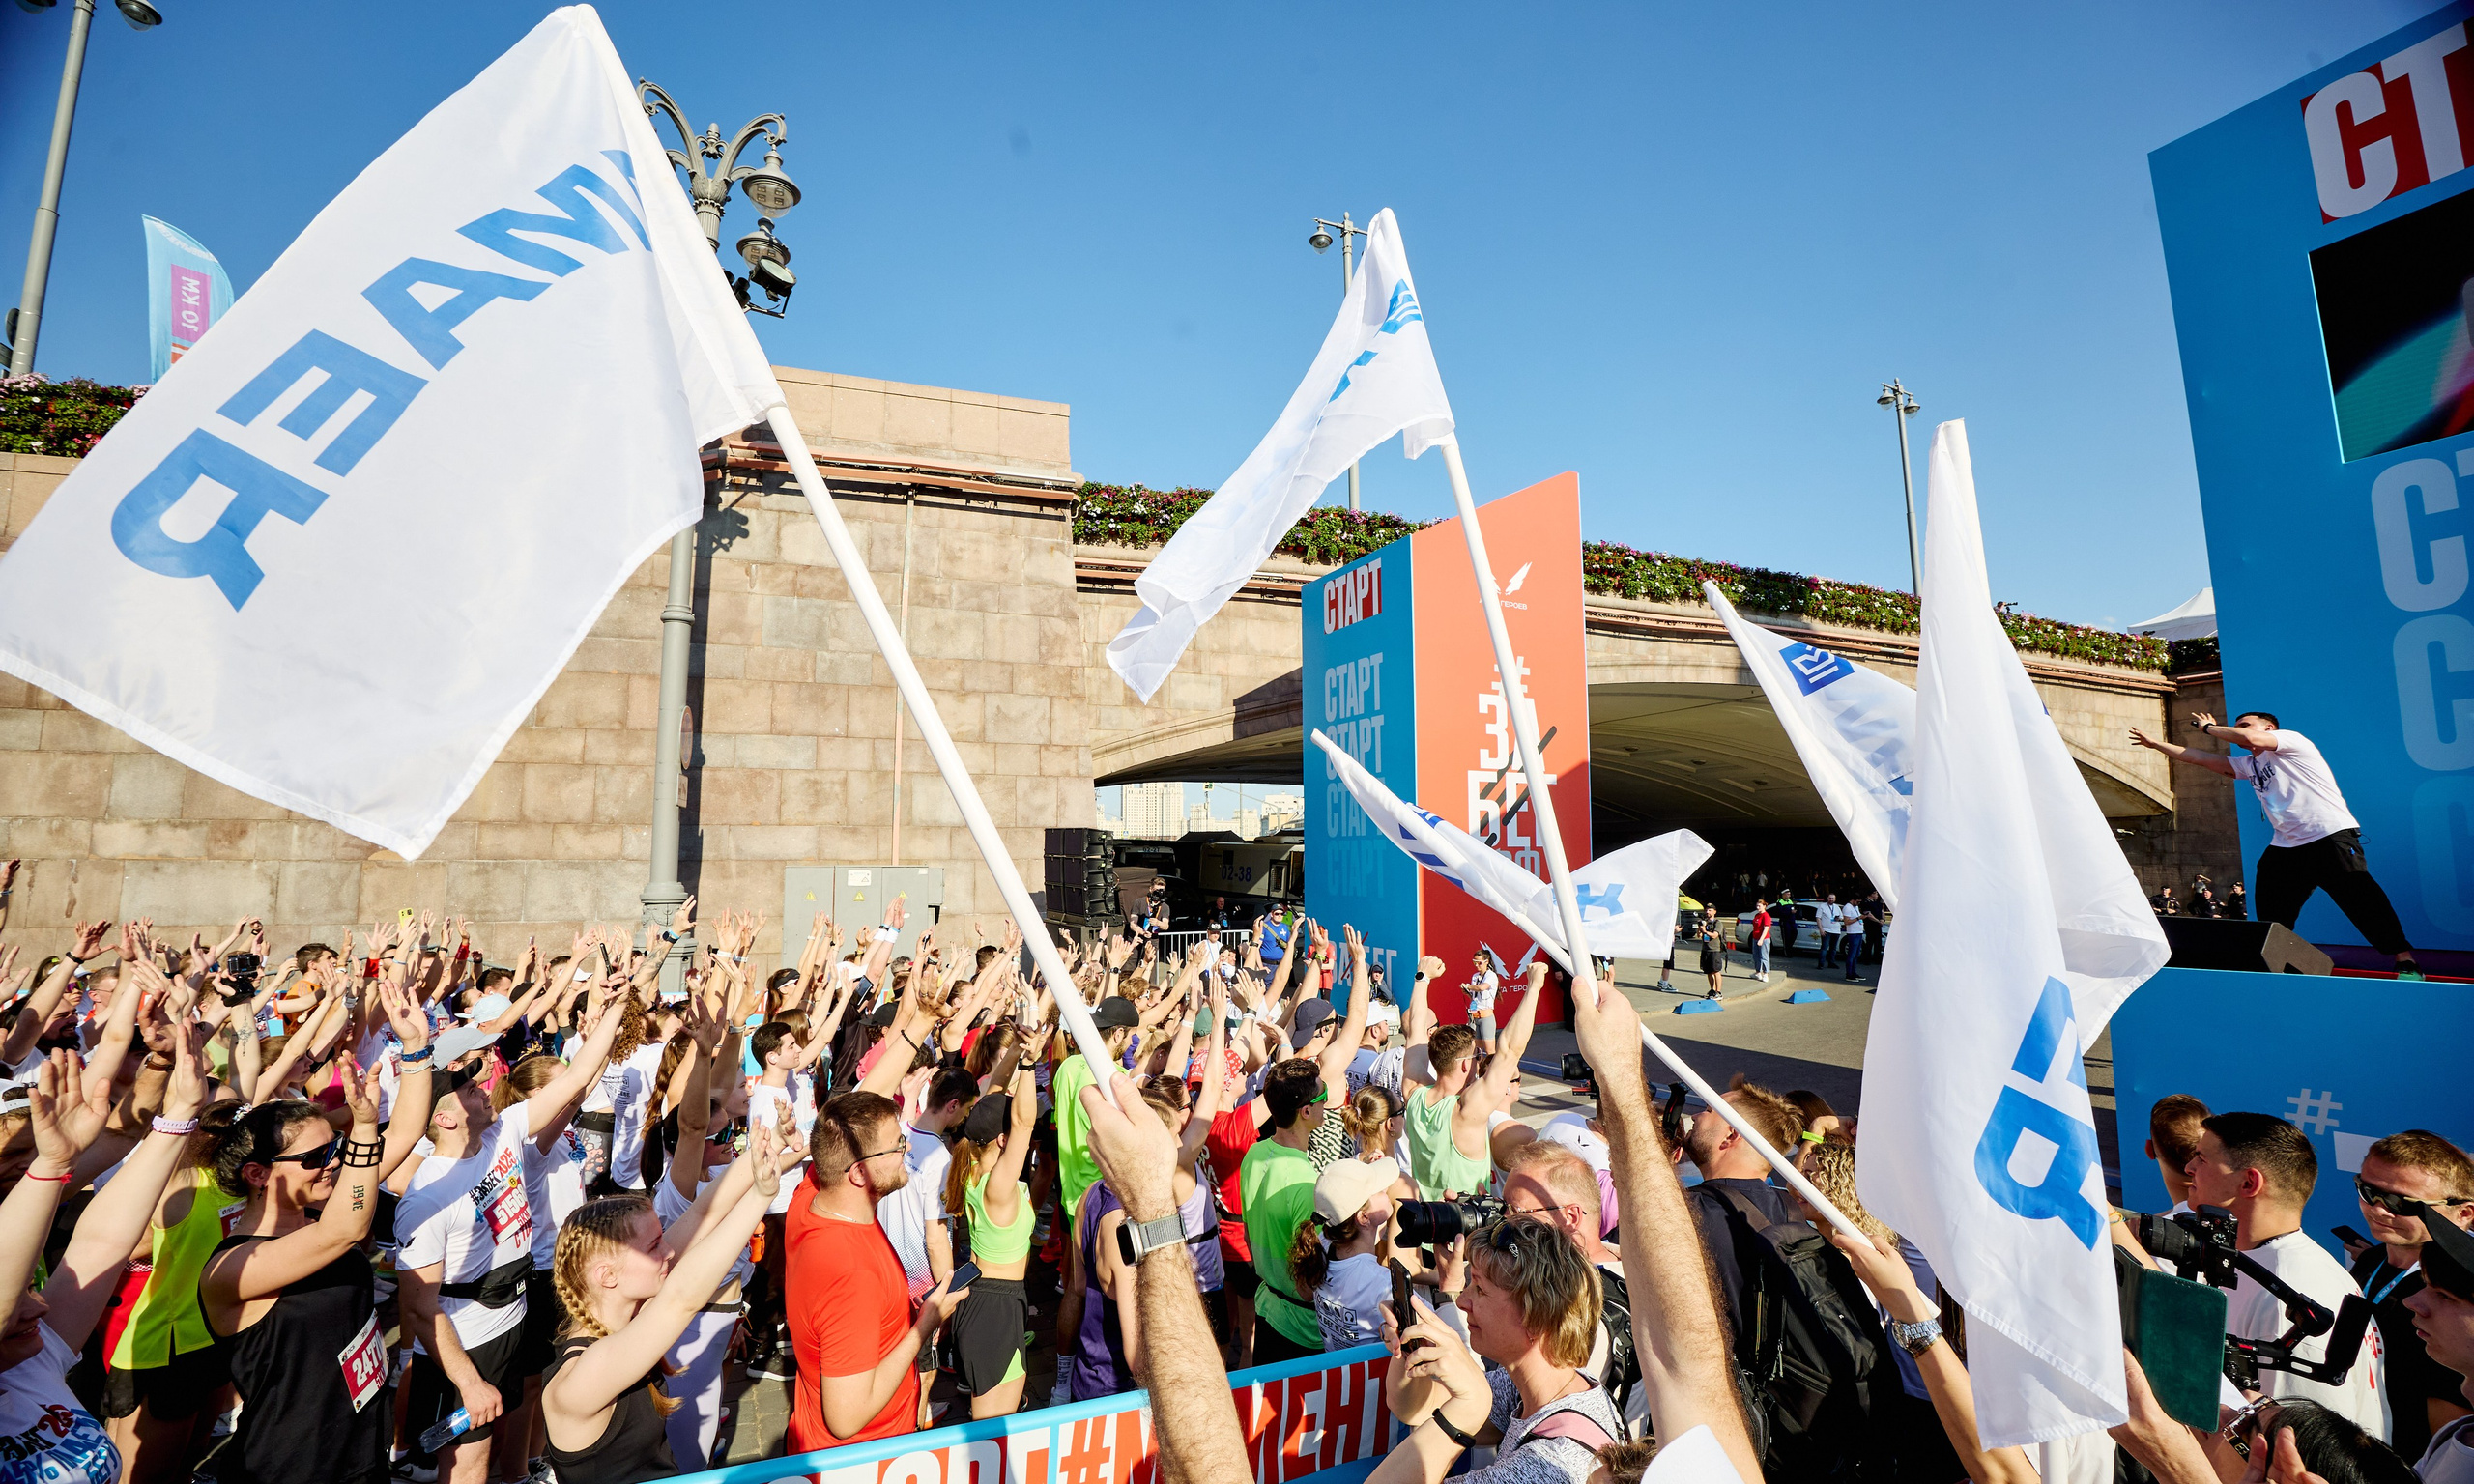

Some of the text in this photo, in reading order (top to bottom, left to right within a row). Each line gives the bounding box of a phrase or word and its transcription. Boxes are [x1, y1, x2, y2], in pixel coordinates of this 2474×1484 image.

[1323, 557, 1382, 635] СТАРТ
[1500, 600, 1528, 611] ГЕРОЕВ
[1325, 652, 1384, 723] СТАРТ
[1326, 776, 1386, 839] СТА
[1222, 866, 1251, 882] 02-38
[1327, 834, 1387, 898] СТАРТ
[352, 1184, 365, 1212] ЗАБЕГ
[1059, 1356, 1392, 1484] #ММЕНТ
